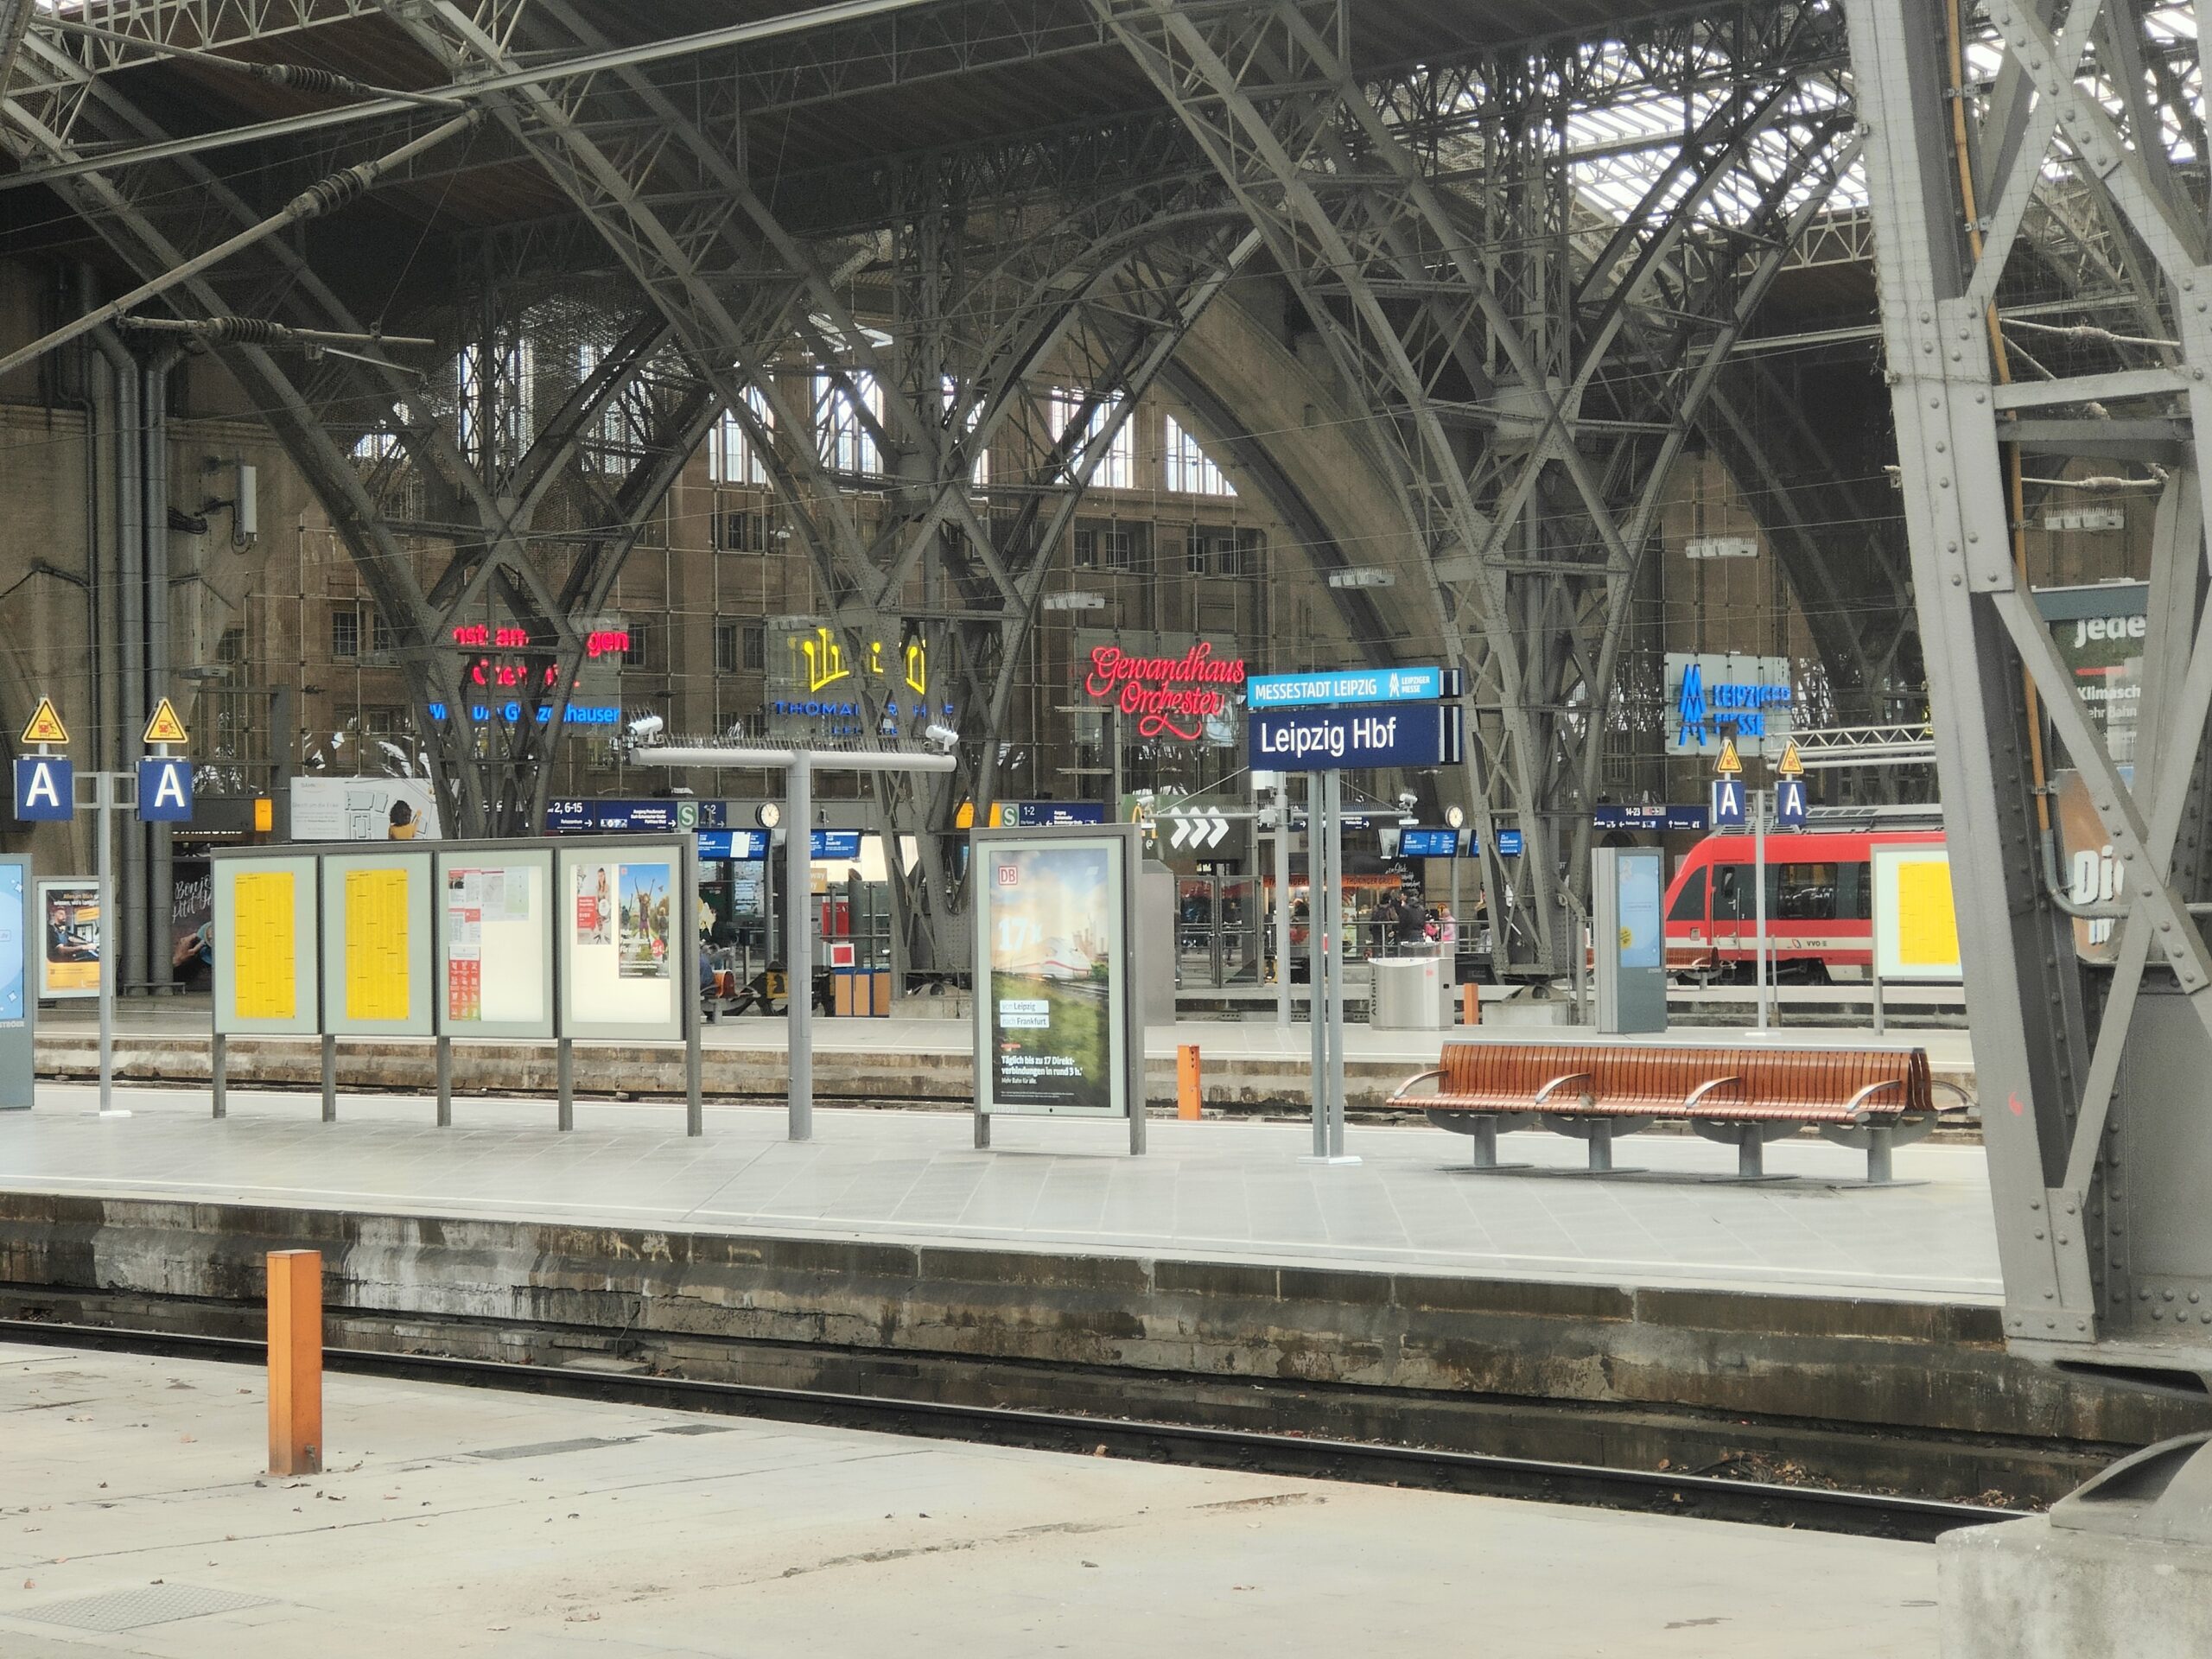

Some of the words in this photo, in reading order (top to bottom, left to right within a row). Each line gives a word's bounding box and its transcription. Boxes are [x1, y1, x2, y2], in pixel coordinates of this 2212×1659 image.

[1086, 642, 1245, 696] Gewandhaus
[1402, 676, 1430, 684] LEIPZIGER
[1402, 684, 1421, 693] MESSE
[1255, 681, 1332, 701] MESSESTADT
[1334, 679, 1377, 697] LEIPZIG
[1121, 679, 1225, 741] Orchester
[1262, 720, 1344, 758] Leipzig
[1353, 716, 1396, 748] Hbf
[26, 762, 60, 807] A
[154, 764, 185, 807] A
[564, 802, 583, 813] 6-15
[1720, 783, 1738, 816] A
[1785, 784, 1802, 816] A
[681, 807, 695, 826] S
[1004, 808, 1016, 826] S
[1024, 806, 1035, 816] 1-2
[1000, 868, 1017, 884] DB
[1017, 1017, 1046, 1026] Frankfurt
[1001, 1055, 1024, 1065] Täglich
[1025, 1055, 1034, 1065] bis
[1001, 1066, 1045, 1077] verbindungen
